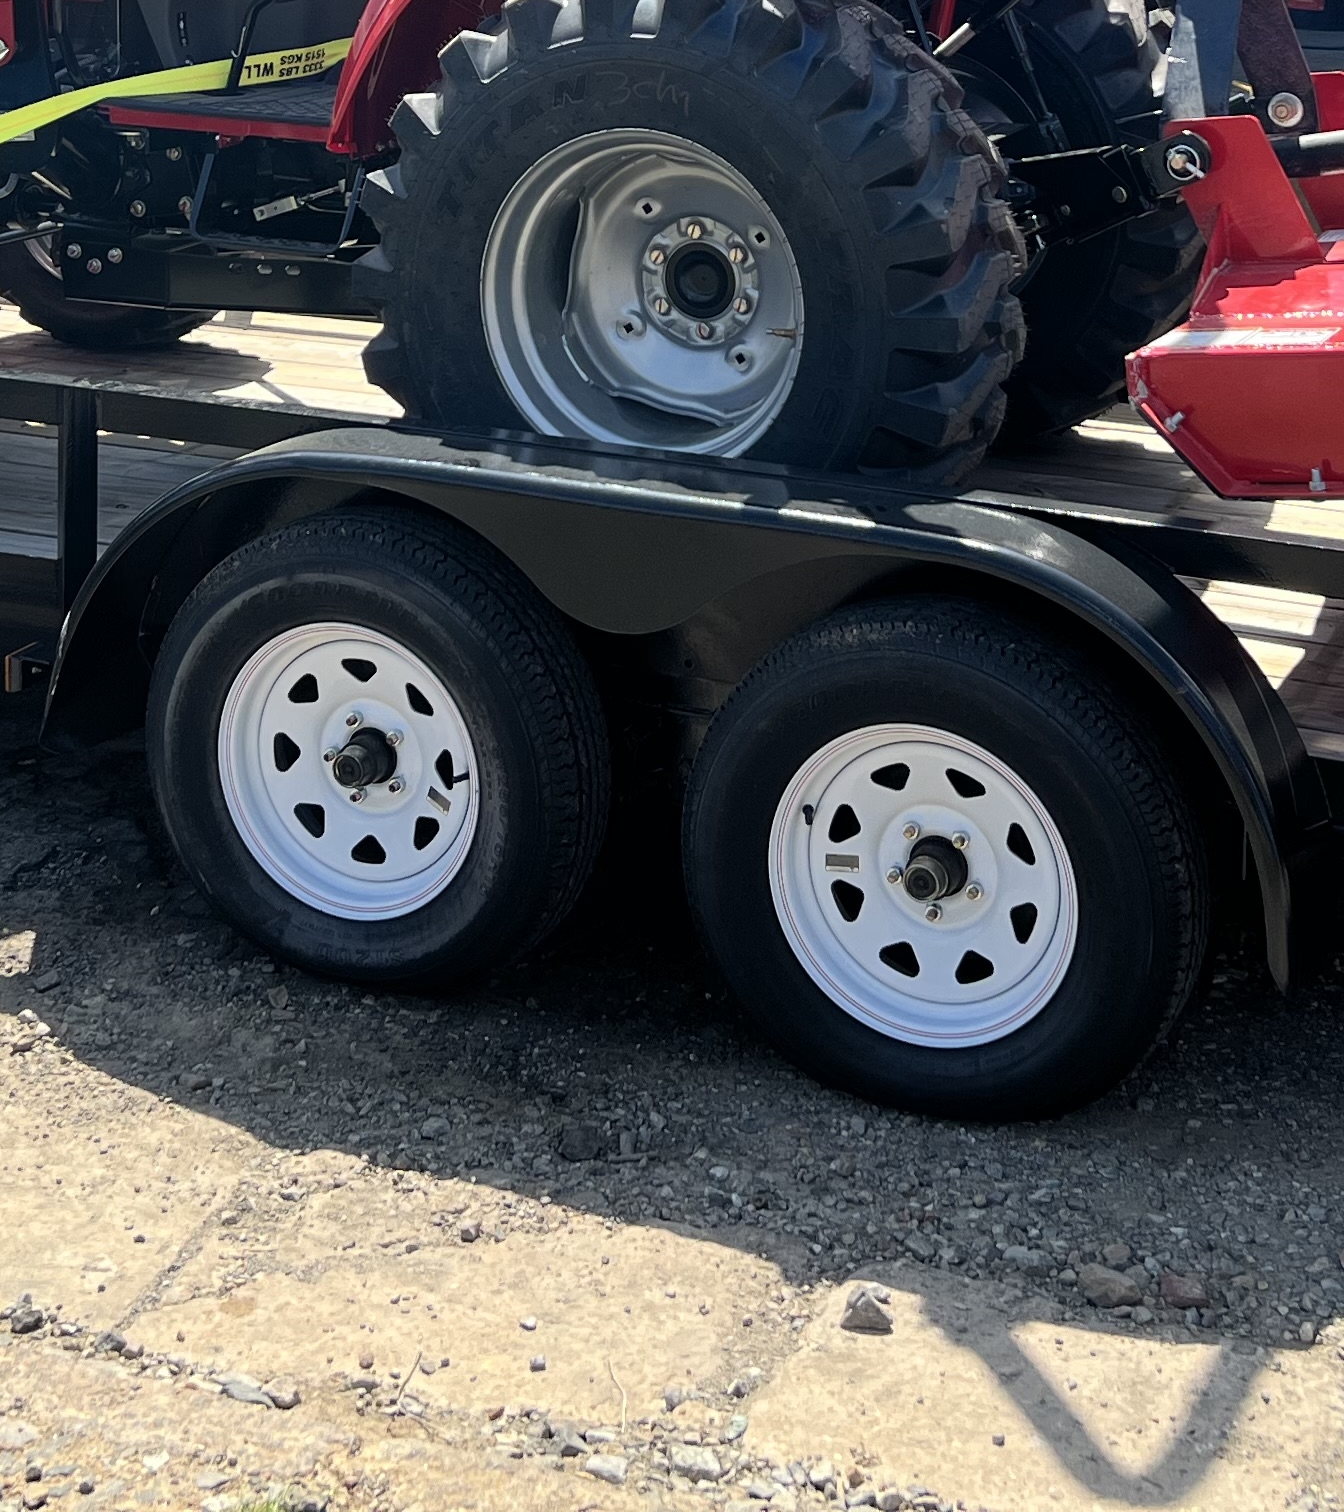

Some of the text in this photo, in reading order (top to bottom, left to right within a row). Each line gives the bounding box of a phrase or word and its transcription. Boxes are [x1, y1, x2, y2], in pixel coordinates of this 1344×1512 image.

[280, 53, 303, 65] KGS
[244, 61, 274, 79] WLL
[278, 65, 299, 78] LBS
